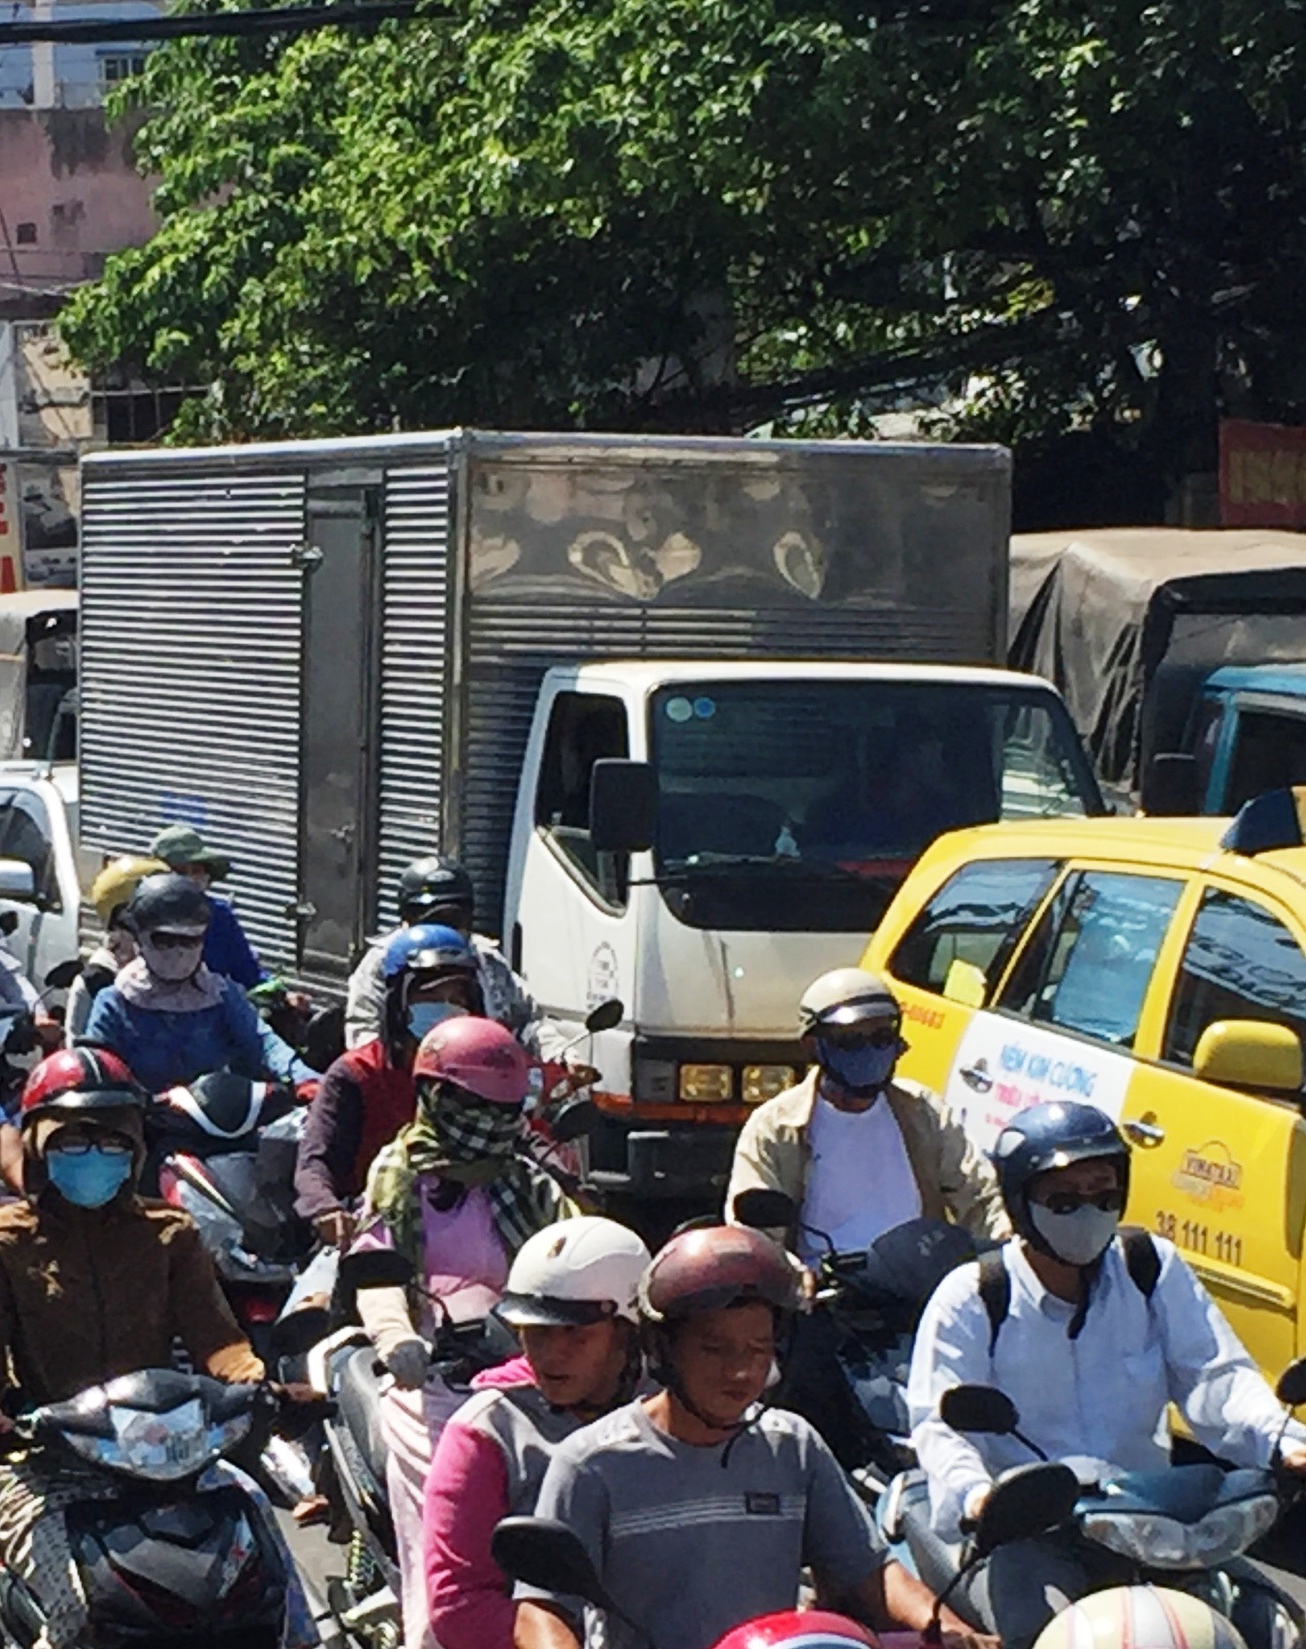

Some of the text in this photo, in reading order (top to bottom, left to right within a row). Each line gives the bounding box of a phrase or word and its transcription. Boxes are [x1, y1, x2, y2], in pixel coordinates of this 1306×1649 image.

[1155, 1209, 1243, 1269] 38 111 111
